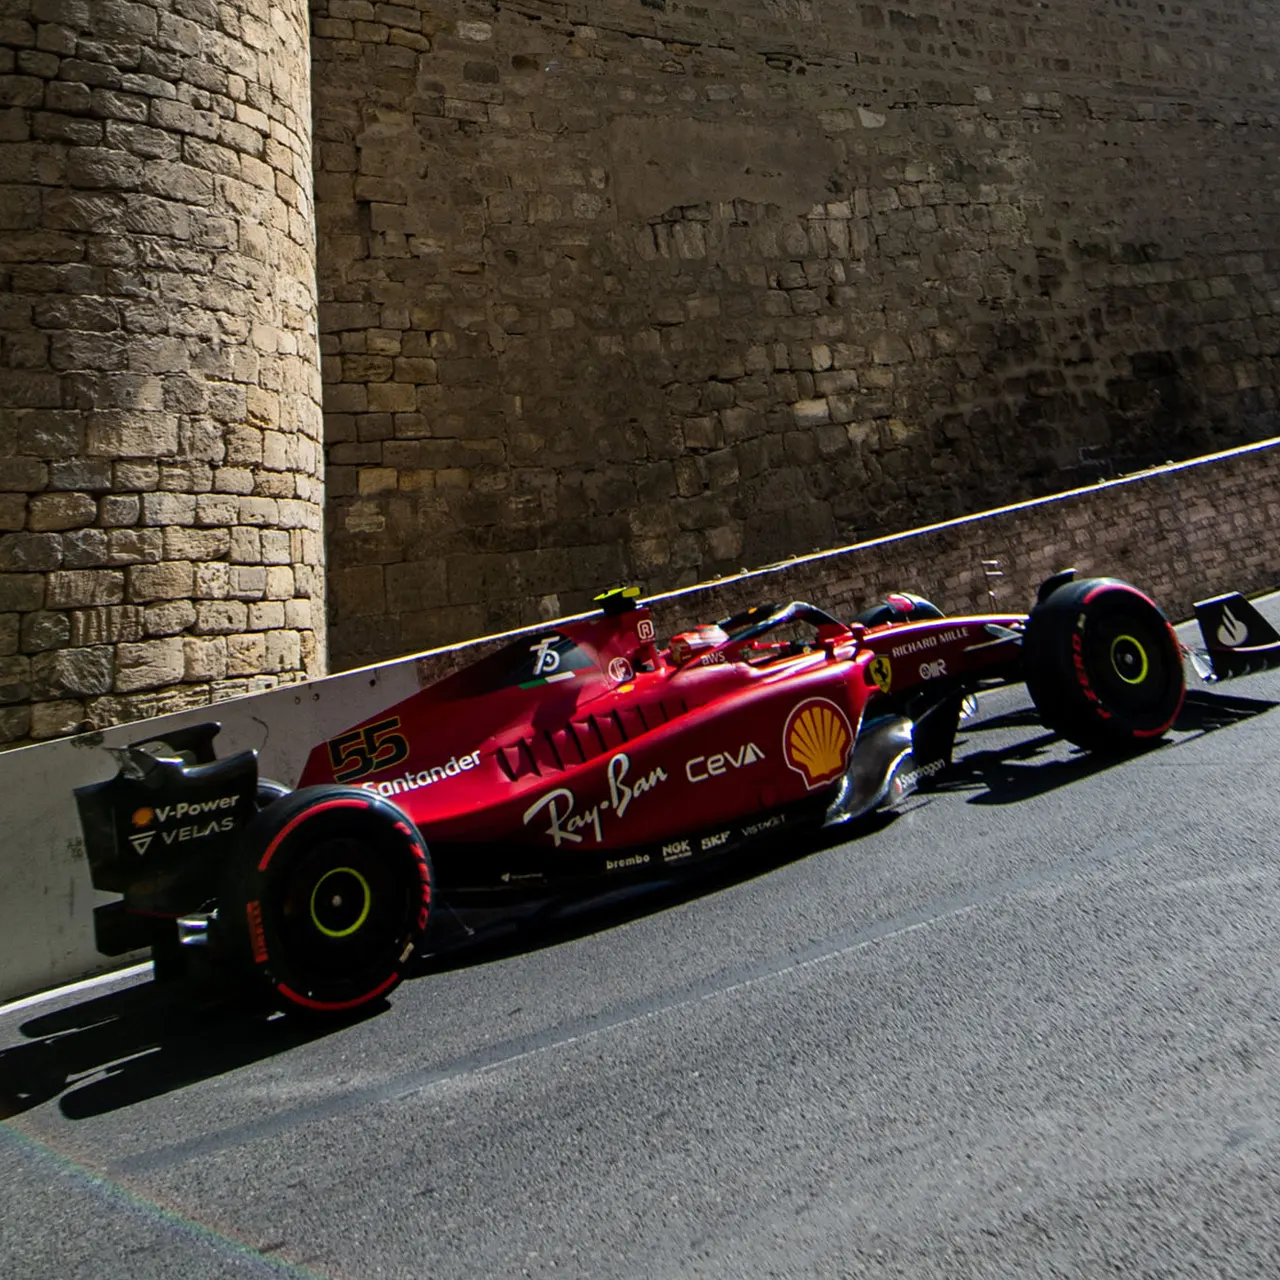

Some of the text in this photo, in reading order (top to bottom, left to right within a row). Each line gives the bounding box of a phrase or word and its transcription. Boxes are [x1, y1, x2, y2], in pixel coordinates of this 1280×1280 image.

[892, 626, 970, 658] RICHARD MILLE
[700, 651, 726, 666] aws
[327, 715, 410, 785] 55
[361, 749, 481, 797] Santander
[155, 795, 241, 823] V-Power
[161, 817, 235, 845] VELAS
[606, 854, 651, 869] brembo
[662, 840, 691, 856] NGK
[701, 830, 731, 850] SKF
